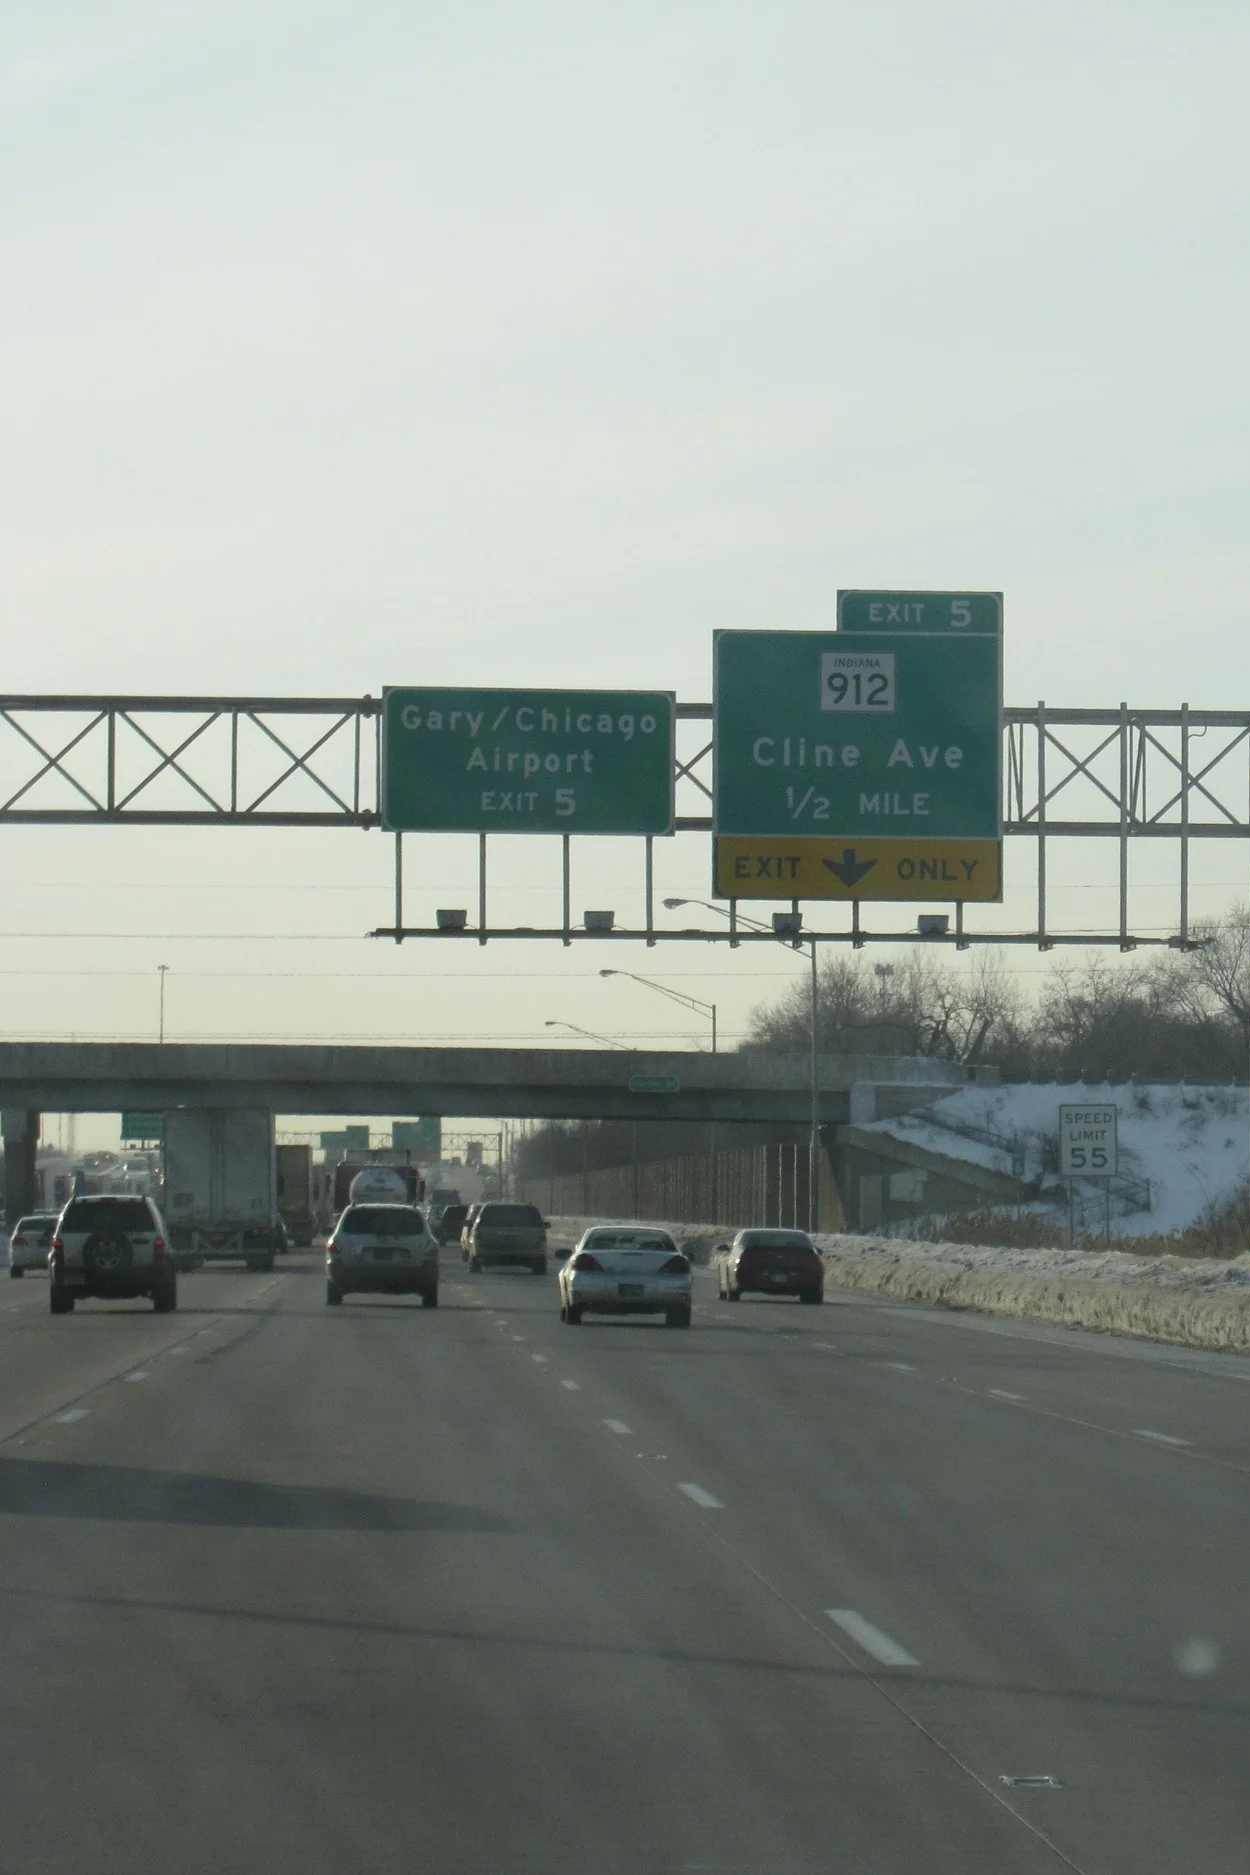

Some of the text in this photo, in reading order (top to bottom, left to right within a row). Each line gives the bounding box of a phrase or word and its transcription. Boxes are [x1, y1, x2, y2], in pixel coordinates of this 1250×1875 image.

[868, 600, 972, 627] EXIT 5
[834, 657, 880, 669] INDIANA
[826, 672, 889, 706] 912
[401, 704, 657, 741] Gary/Chicago
[465, 747, 594, 779] Airport
[753, 737, 964, 769] Cline Ave
[480, 788, 577, 817] EXIT 5
[859, 792, 930, 815] MILE
[734, 856, 979, 881] EXIT ONLY
[1064, 1112, 1112, 1125] SPEED
[1069, 1129, 1107, 1141] LIMIT
[1070, 1147, 1109, 1169] 55
